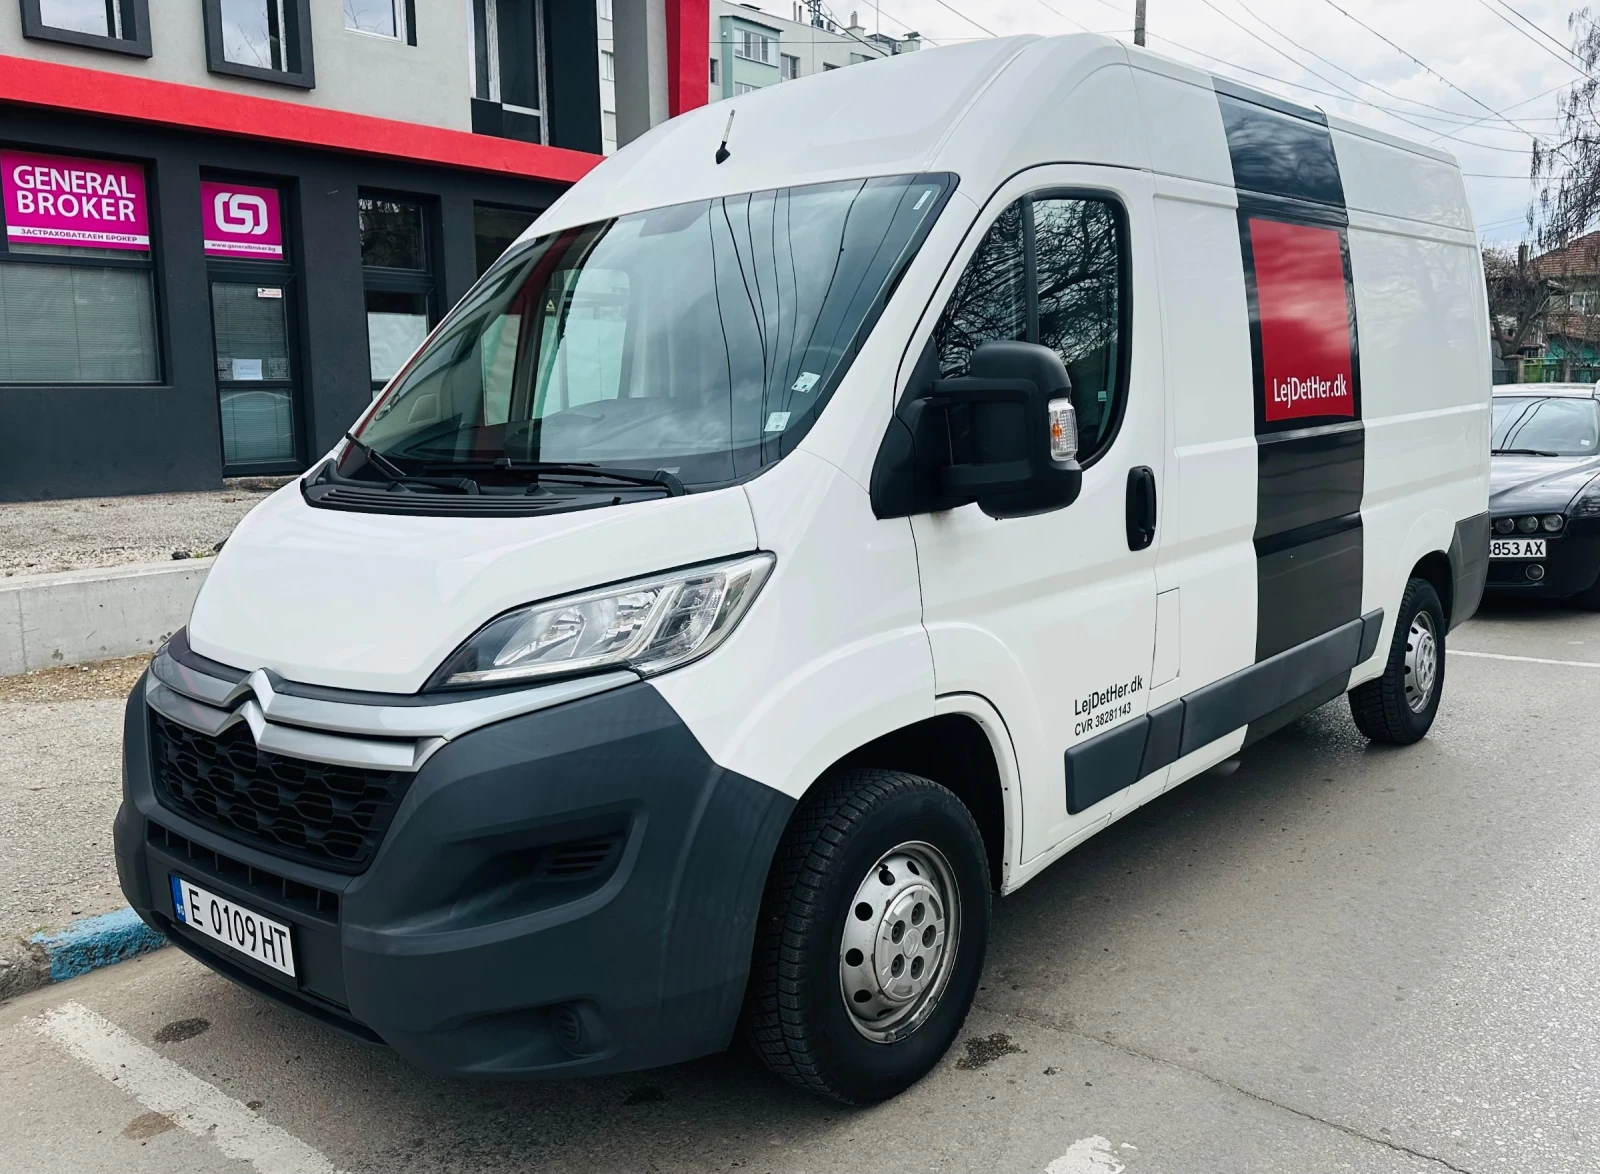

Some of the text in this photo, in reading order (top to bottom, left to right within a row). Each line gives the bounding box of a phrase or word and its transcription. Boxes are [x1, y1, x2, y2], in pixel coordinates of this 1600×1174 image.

[13, 165, 136, 199] GENERAL
[16, 190, 136, 222] BROKER
[20, 228, 138, 243] ЗАСТРАХОВАТЕЛЕН БРОКЕР
[211, 242, 276, 252] www.generalbroker.bg
[1273, 373, 1347, 408] LejDetHer.dk
[1489, 541, 1544, 556] 853 AX
[1074, 674, 1143, 716] LejDetHer.dk
[1074, 702, 1132, 736] CVR 38281143
[188, 888, 204, 927] E
